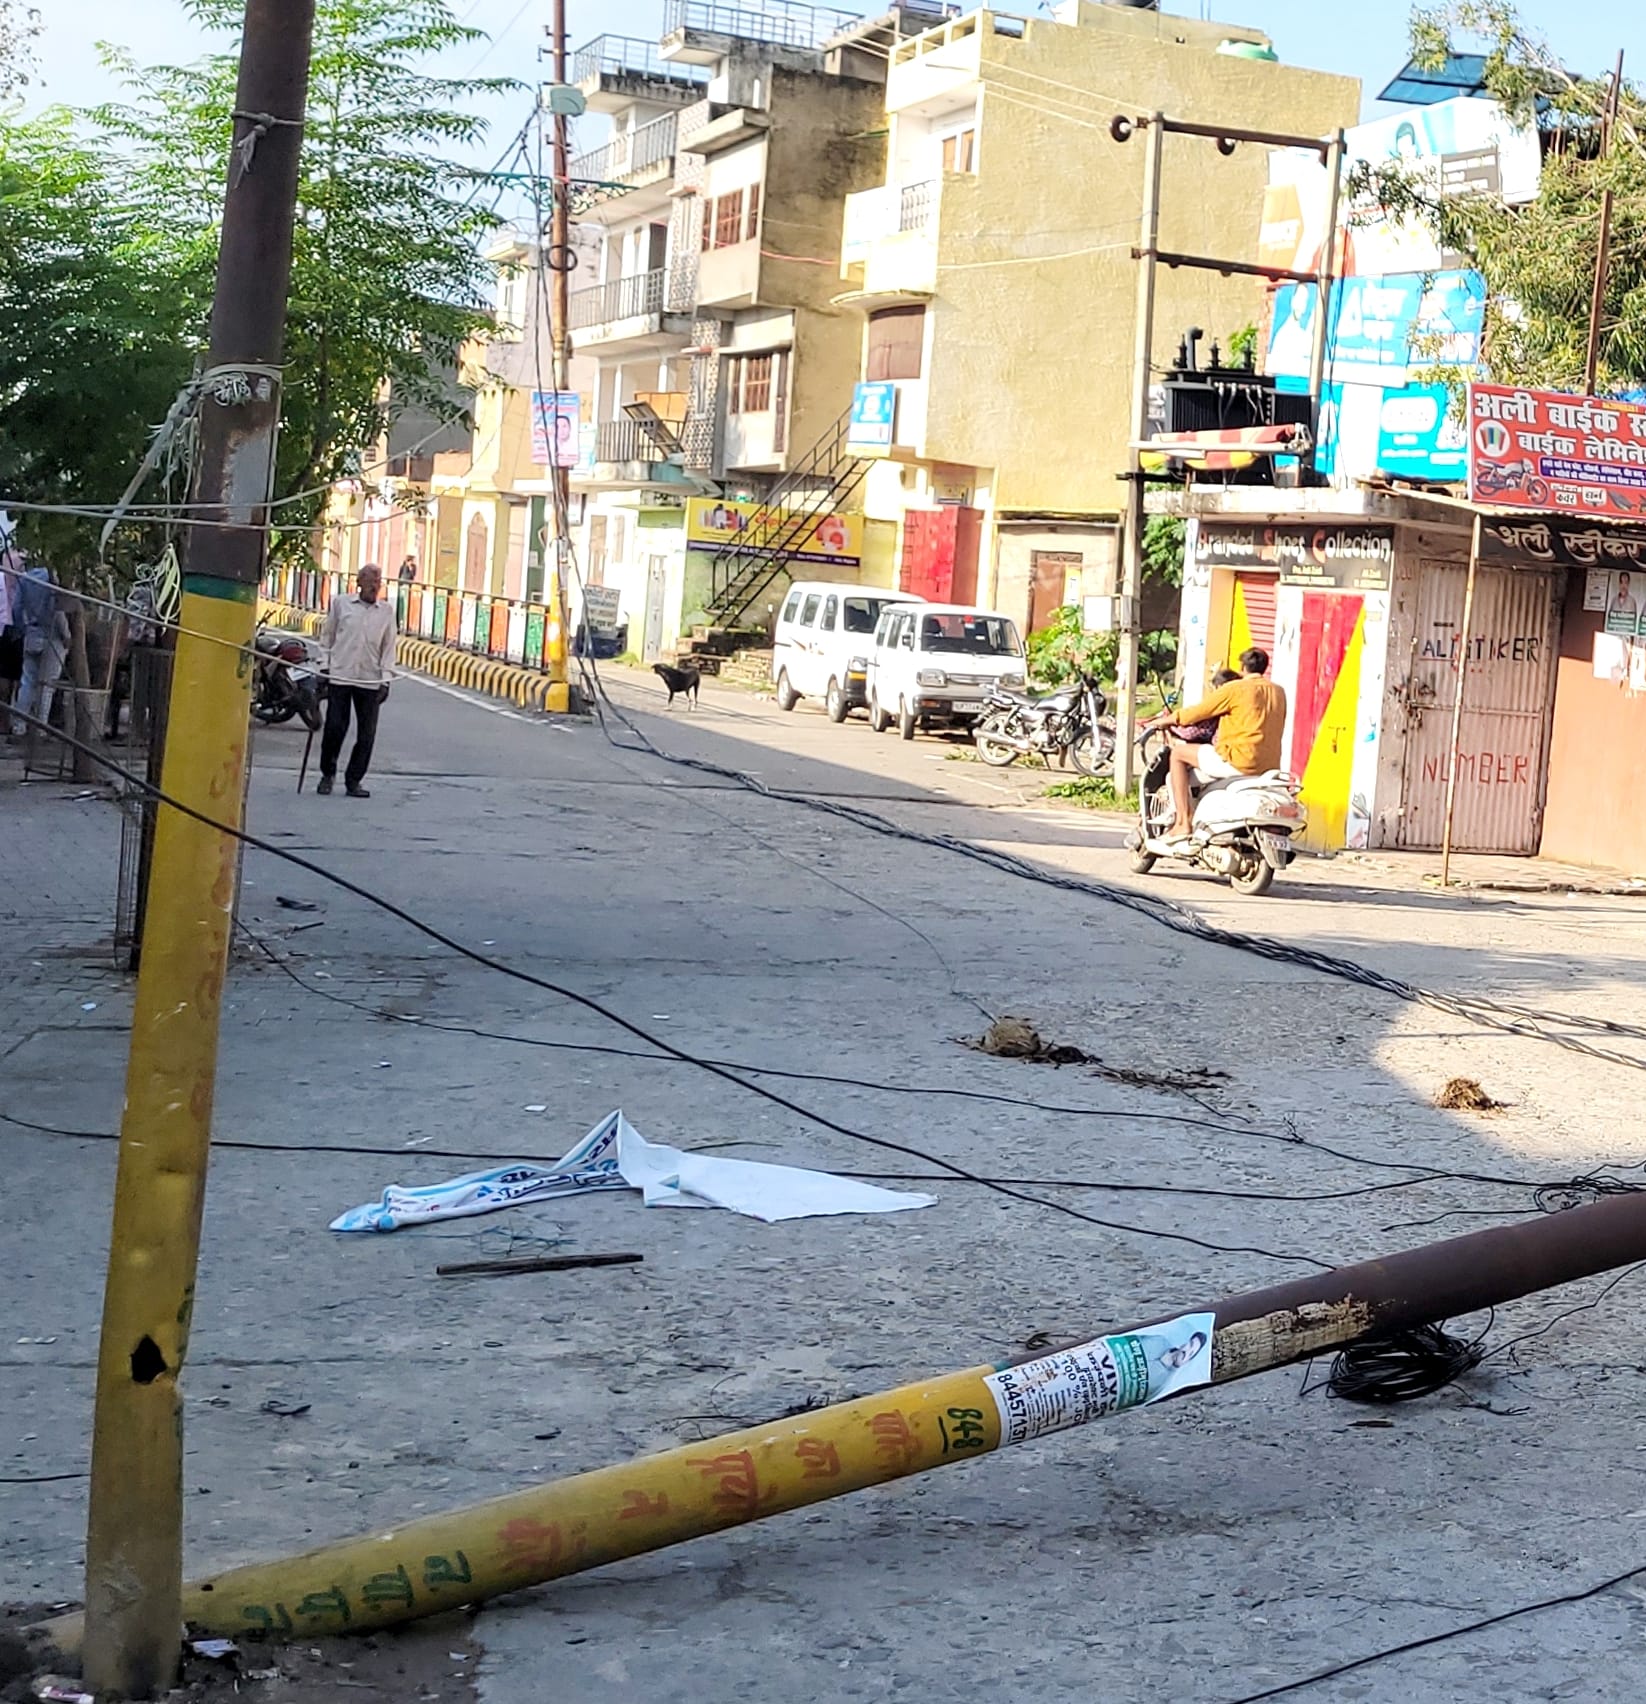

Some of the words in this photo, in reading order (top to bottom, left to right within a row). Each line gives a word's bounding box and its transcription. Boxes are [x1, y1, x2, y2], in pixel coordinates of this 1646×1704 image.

[1474, 391, 1538, 424] अली
[1546, 400, 1619, 434] बाईक
[1515, 430, 1576, 456] बाईक
[1196, 527, 1254, 560] Branded
[1259, 529, 1306, 563] Shoes
[1312, 528, 1391, 563] Collection
[1498, 522, 1555, 560] अली
[1422, 639, 1455, 658] ALI
[1463, 637, 1543, 663] TIKER
[1423, 752, 1528, 784] NUMBER
[1061, 1359, 1077, 1381] 100
[947, 1408, 984, 1449] 848
